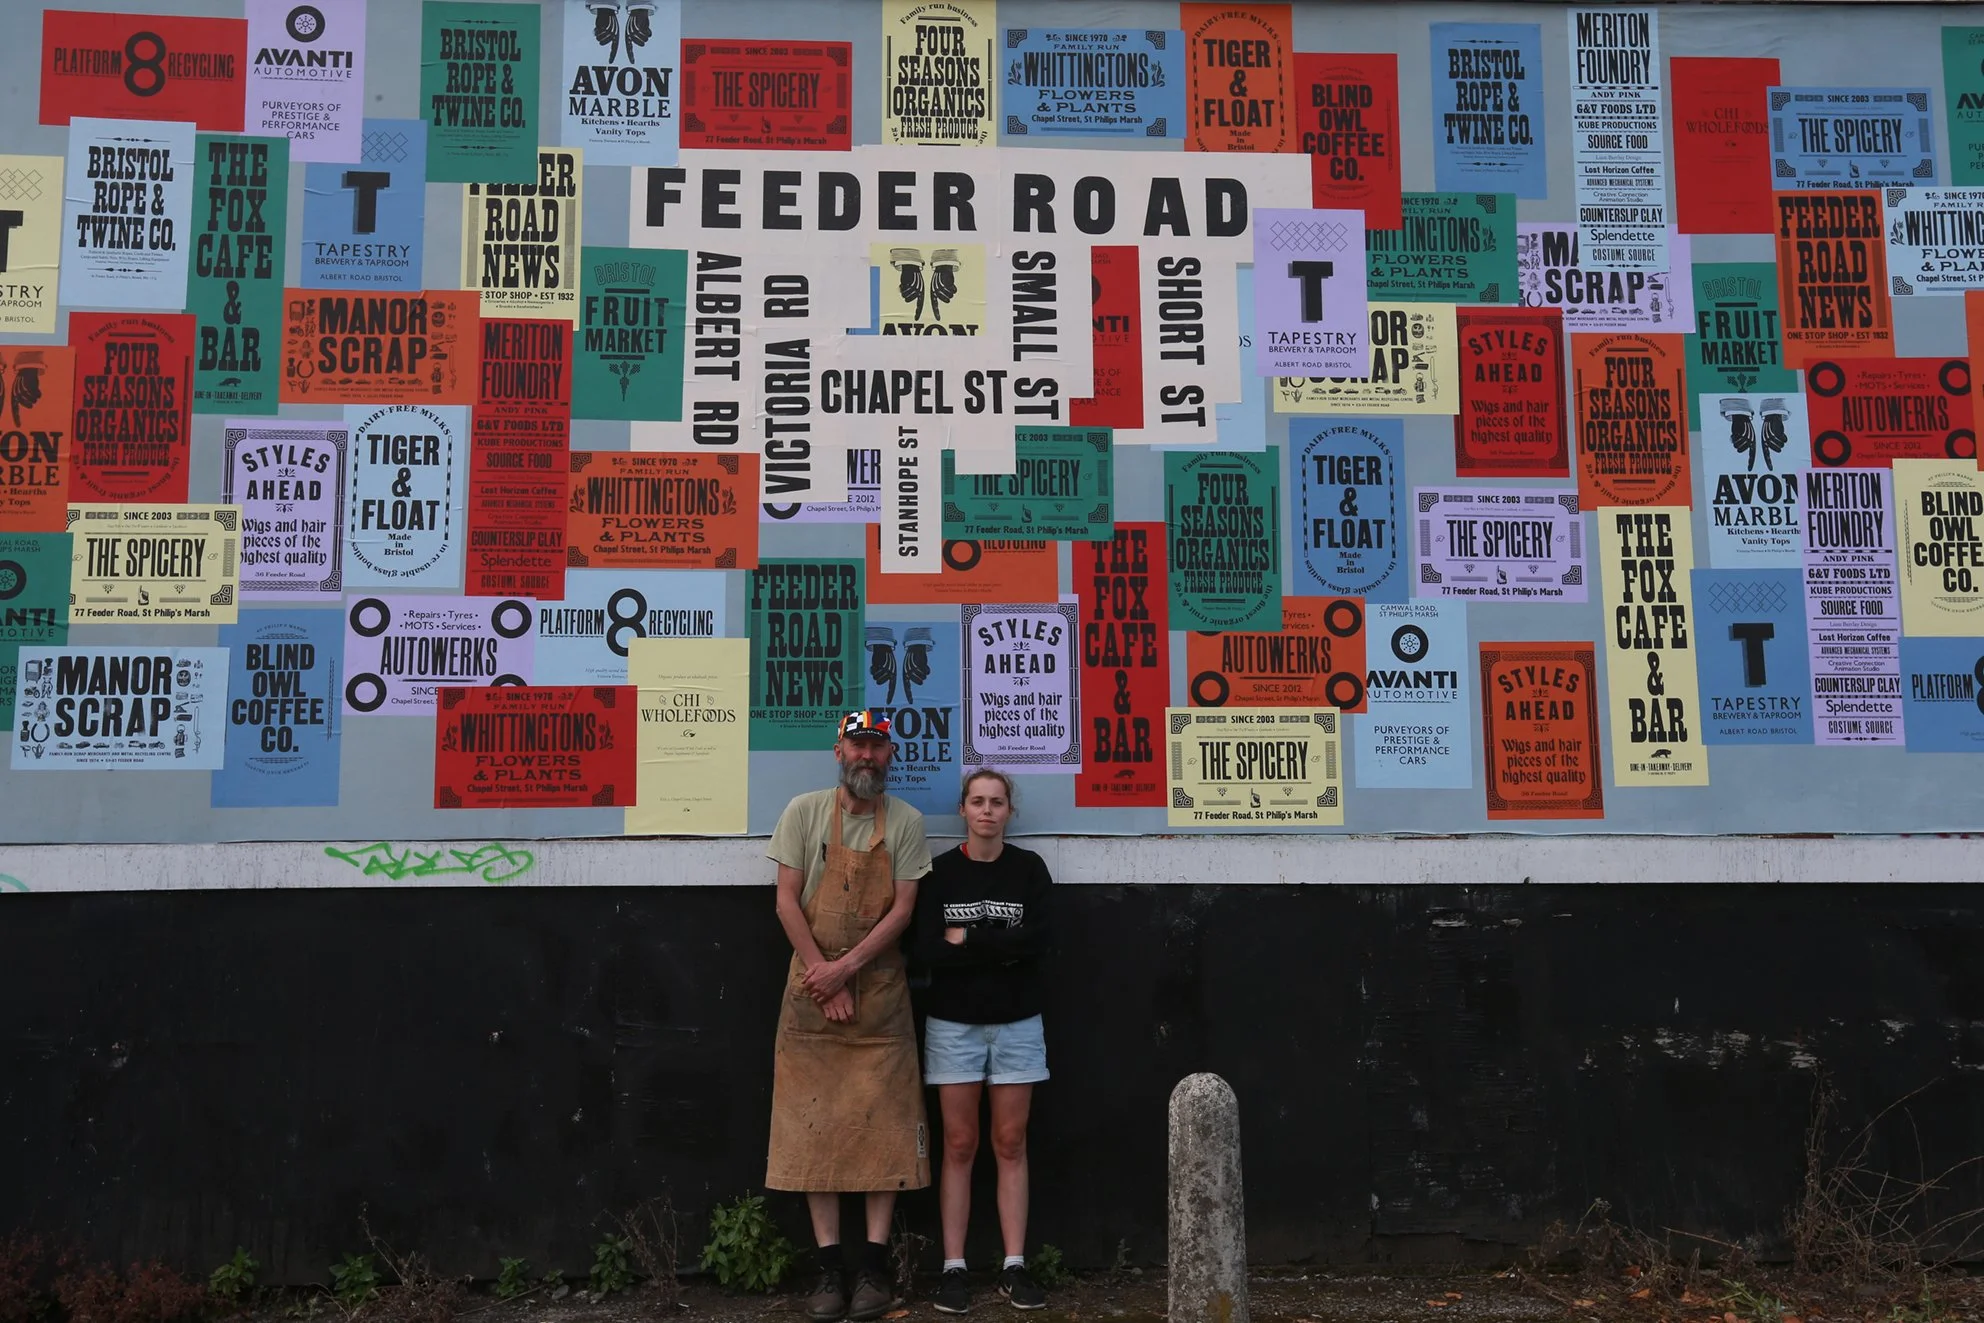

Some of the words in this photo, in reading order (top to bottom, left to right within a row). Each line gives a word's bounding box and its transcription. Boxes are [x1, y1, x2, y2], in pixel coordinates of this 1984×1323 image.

[440, 28, 521, 61] BRISTOL
[916, 25, 965, 57] FOUR
[1577, 13, 1649, 47] MERITON
[54, 48, 122, 75] PLATFORM
[124, 32, 166, 97] 8
[168, 52, 234, 78] RECYCLING
[254, 48, 352, 68] AVANTI
[1024, 52, 1148, 87] WHITTINGTONS
[1203, 39, 1271, 67] TIGER
[1577, 49, 1650, 84] FOUNDRY
[254, 67, 351, 79] AUTOMOTIVE
[446, 62, 496, 94] ROPE
[501, 64, 513, 95] &
[569, 66, 672, 97] AVON
[898, 55, 980, 87] SEASONS
[1229, 69, 1247, 97] &
[262, 101, 324, 112] PURVEYORS
[432, 95, 495, 127] TWINE
[569, 97, 671, 118] MARBLE
[893, 86, 985, 118] ORGANICS
[1037, 102, 1051, 112] &
[1056, 102, 1136, 113] PLANTS
[1039, 89, 1135, 100] FLOWERS
[262, 120, 339, 131] PERFORMANCE
[901, 118, 932, 138] FRESH
[935, 118, 978, 139] PRODUCE
[1204, 99, 1274, 127] FLOAT
[286, 131, 314, 142] CARS
[1588, 135, 1623, 149] SOURCE
[1626, 135, 1648, 149] FOOD
[1798, 118, 1831, 153] THE
[1834, 119, 1901, 153] SPICERY
[208, 142, 268, 187] THE
[208, 187, 266, 233] FOX
[646, 168, 977, 231] FEEDER
[1013, 173, 1248, 237] ROAD
[1580, 208, 1638, 222] COUNTERSLIP
[1641, 208, 1662, 222] CLAY
[1779, 196, 1880, 239] FEEDER
[485, 198, 559, 242] ROAD
[1591, 229, 1654, 244] Splendette
[197, 233, 272, 279] CAFE
[482, 244, 559, 289] NEWS
[1797, 240, 1867, 283] ROAD
[223, 281, 241, 325] &
[764, 275, 809, 318] RD
[1012, 251, 1057, 362] SMALL
[1289, 261, 1333, 323] T
[1798, 286, 1872, 328] NEWS
[585, 296, 669, 326] FRUIT
[696, 250, 742, 381] ALBERT
[1158, 257, 1205, 365] SHORT
[199, 326, 261, 372] BAR
[585, 328, 667, 353] MARKET
[1268, 332, 1356, 345] TAPESTRY
[821, 370, 953, 414] CHAPEL
[965, 370, 1007, 414] ST
[1014, 378, 1059, 420] ST
[1160, 385, 1206, 427] ST
[693, 402, 739, 445] RD
[764, 337, 811, 495] VICTORIA
[898, 426, 918, 448] ST
[242, 444, 330, 476] STYLES
[1313, 455, 1382, 485] TIGER
[247, 480, 321, 500] AHEAD
[1198, 473, 1249, 505] FOUR
[1806, 473, 1882, 509] MERITON
[898, 457, 918, 557] STANHOPE
[1181, 505, 1264, 538] SEASONS
[1313, 519, 1385, 549] FLOAT
[1447, 520, 1478, 557] THE
[1483, 521, 1552, 558] SPICERY
[1616, 514, 1673, 557] THE
[1808, 511, 1883, 547] FOUNDRY
[87, 538, 121, 577] THE
[126, 539, 205, 577] SPICERY
[1176, 538, 1269, 571] ORGANICS
[751, 564, 858, 610] FEEDER
[1621, 559, 1676, 603] FOX
[409, 610, 440, 620] Repairs
[448, 610, 473, 621] Tyres
[540, 609, 604, 635] PLATFORM
[649, 610, 713, 635] RECYCLING
[1616, 605, 1687, 649] CAFE
[767, 612, 842, 658] ROAD
[978, 618, 1062, 649] STYLES
[246, 644, 314, 670] BLIND
[380, 636, 497, 676] AUTOWERKS
[985, 654, 1055, 673] AHEAD
[56, 656, 172, 695] MANOR
[253, 671, 306, 697] OWL
[766, 660, 843, 706] NEWS
[1366, 671, 1457, 689] AVANTI
[1498, 666, 1579, 696] STYLES
[1912, 674, 1974, 699] PLATFORM
[232, 698, 324, 725] COFFEE
[673, 694, 699, 707] CHI
[980, 693, 1010, 708] Wigs
[1014, 692, 1034, 706] and
[1039, 692, 1062, 706] hair
[985, 708, 1020, 723] pieces
[1024, 708, 1039, 721] of
[1040, 708, 1058, 721] the
[1506, 700, 1574, 720] AHEAD
[1712, 697, 1800, 710] TAPESTRY
[54, 698, 171, 737] SCRAP
[461, 713, 596, 752] WHITTINGTONS
[979, 724, 1020, 739] highest
[1025, 723, 1065, 739] quality
[1629, 698, 1687, 743] BAR
[1199, 742, 1231, 780] THE
[1236, 741, 1308, 780] SPICERY
